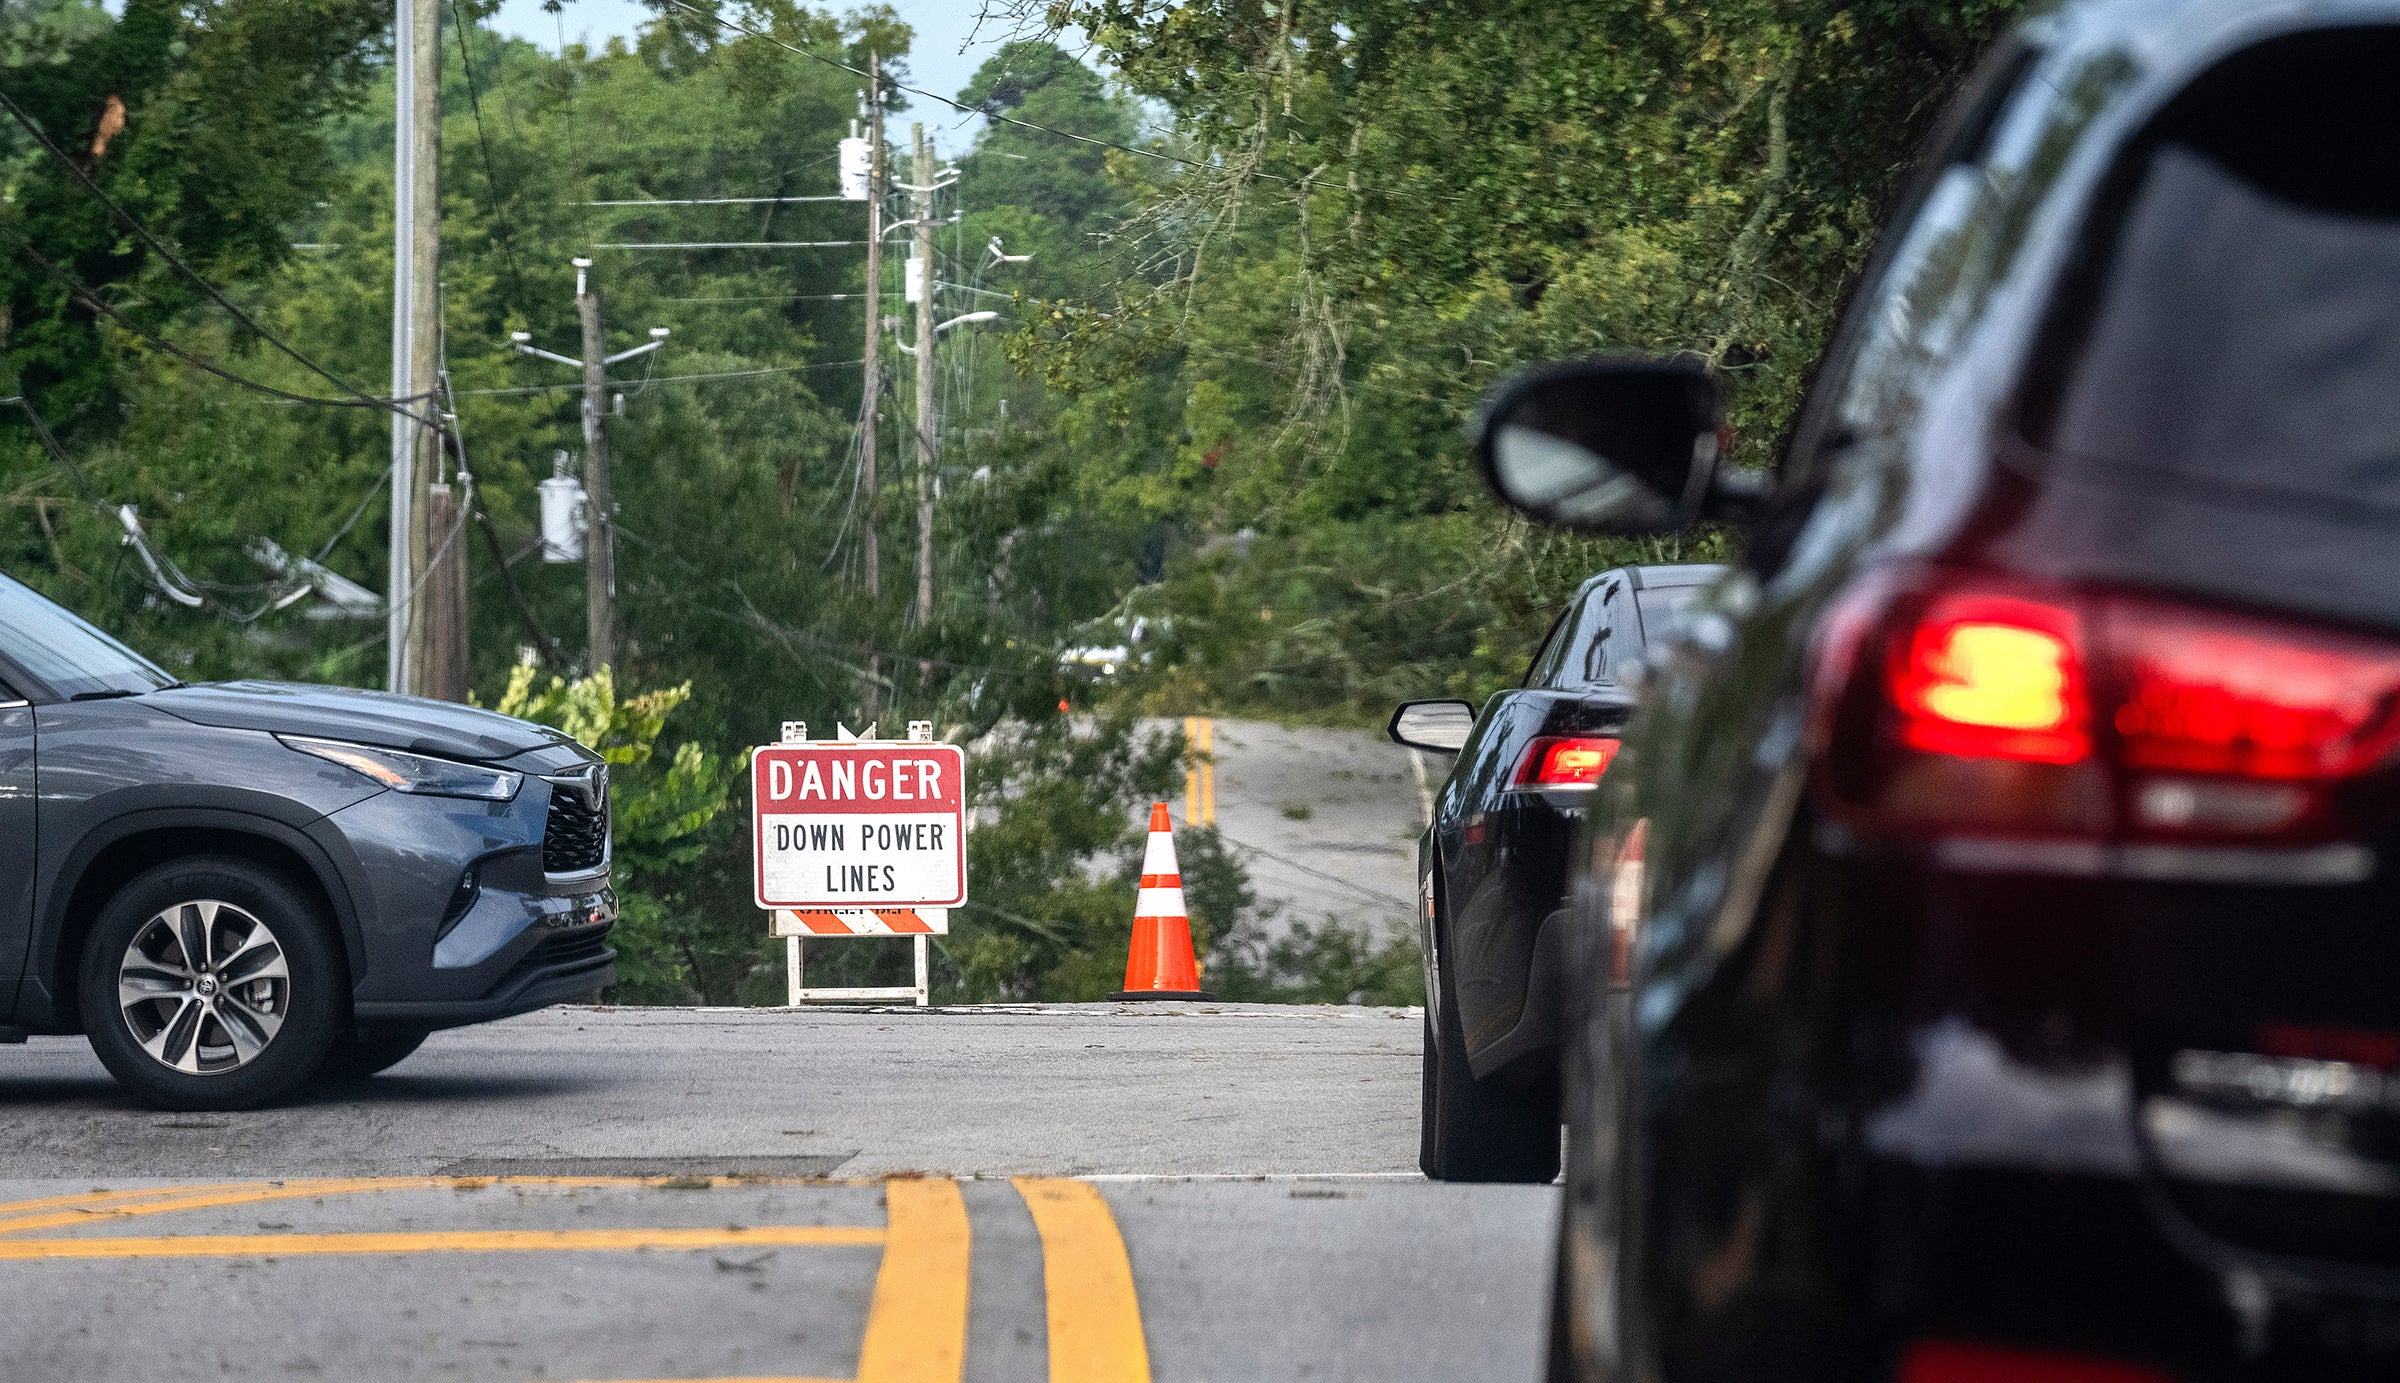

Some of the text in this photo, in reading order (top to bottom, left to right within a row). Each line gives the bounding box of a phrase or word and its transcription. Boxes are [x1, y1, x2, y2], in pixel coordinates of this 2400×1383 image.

[769, 759, 942, 801] DANGER
[777, 823, 944, 851] DOWN POWER
[826, 865, 895, 892] LINES
